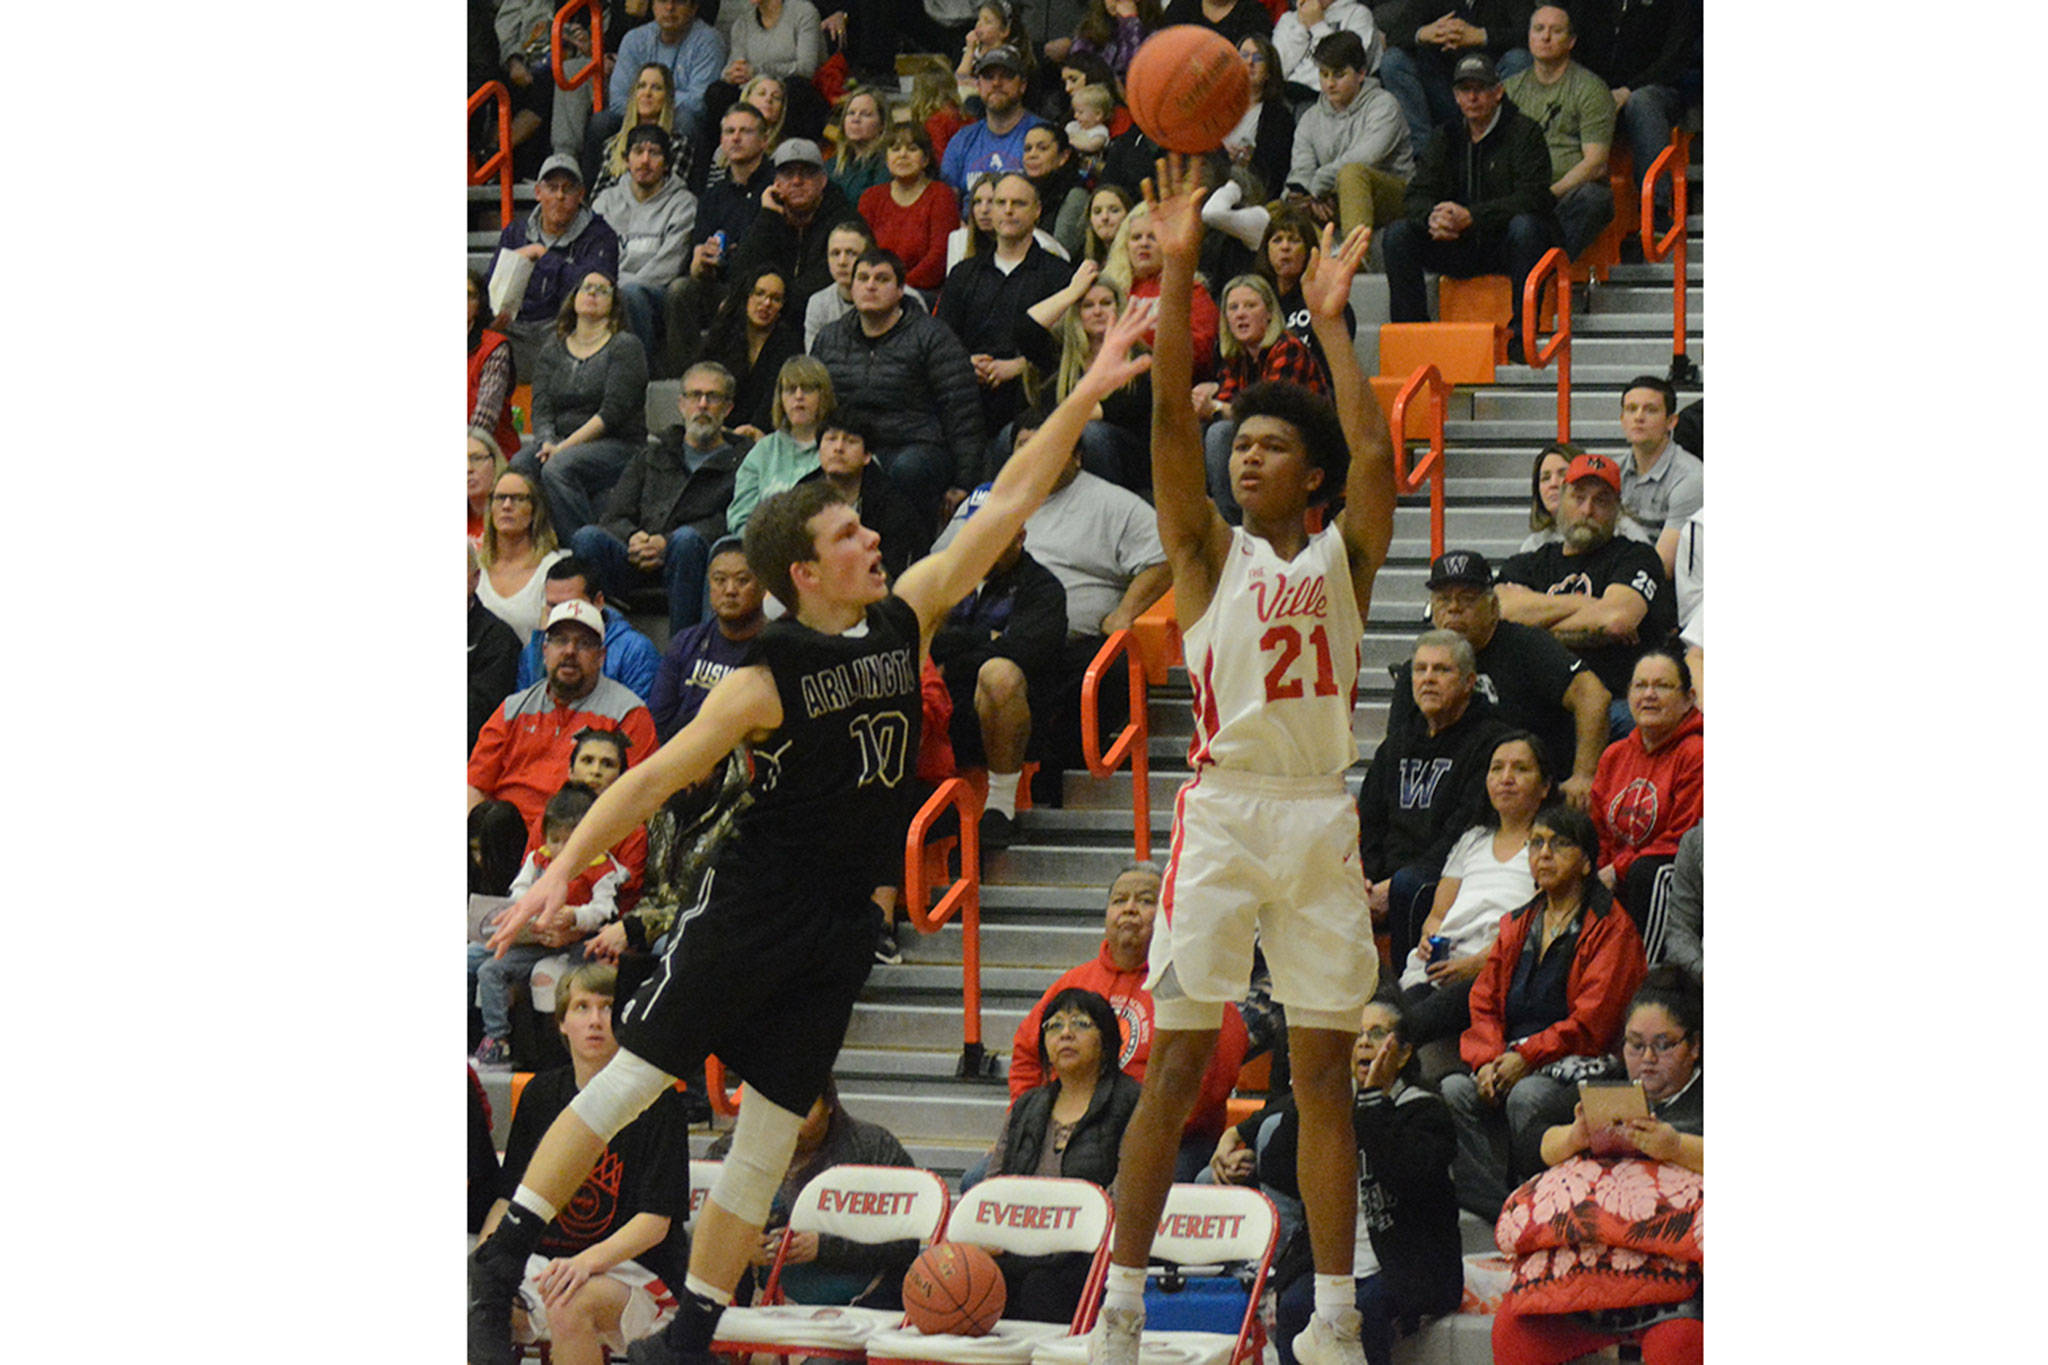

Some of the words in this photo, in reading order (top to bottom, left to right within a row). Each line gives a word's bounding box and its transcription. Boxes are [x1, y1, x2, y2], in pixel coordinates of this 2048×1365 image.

[1443, 555, 1469, 576] W
[1249, 573, 1328, 623] Ville
[1631, 569, 1658, 601] 25
[1260, 624, 1339, 703] 21
[850, 711, 910, 789] 10
[1400, 757, 1453, 809] W
[817, 1187, 918, 1216] EVERETT
[976, 1200, 1082, 1230] EVERETT
[1157, 1212, 1247, 1239] VERETT
